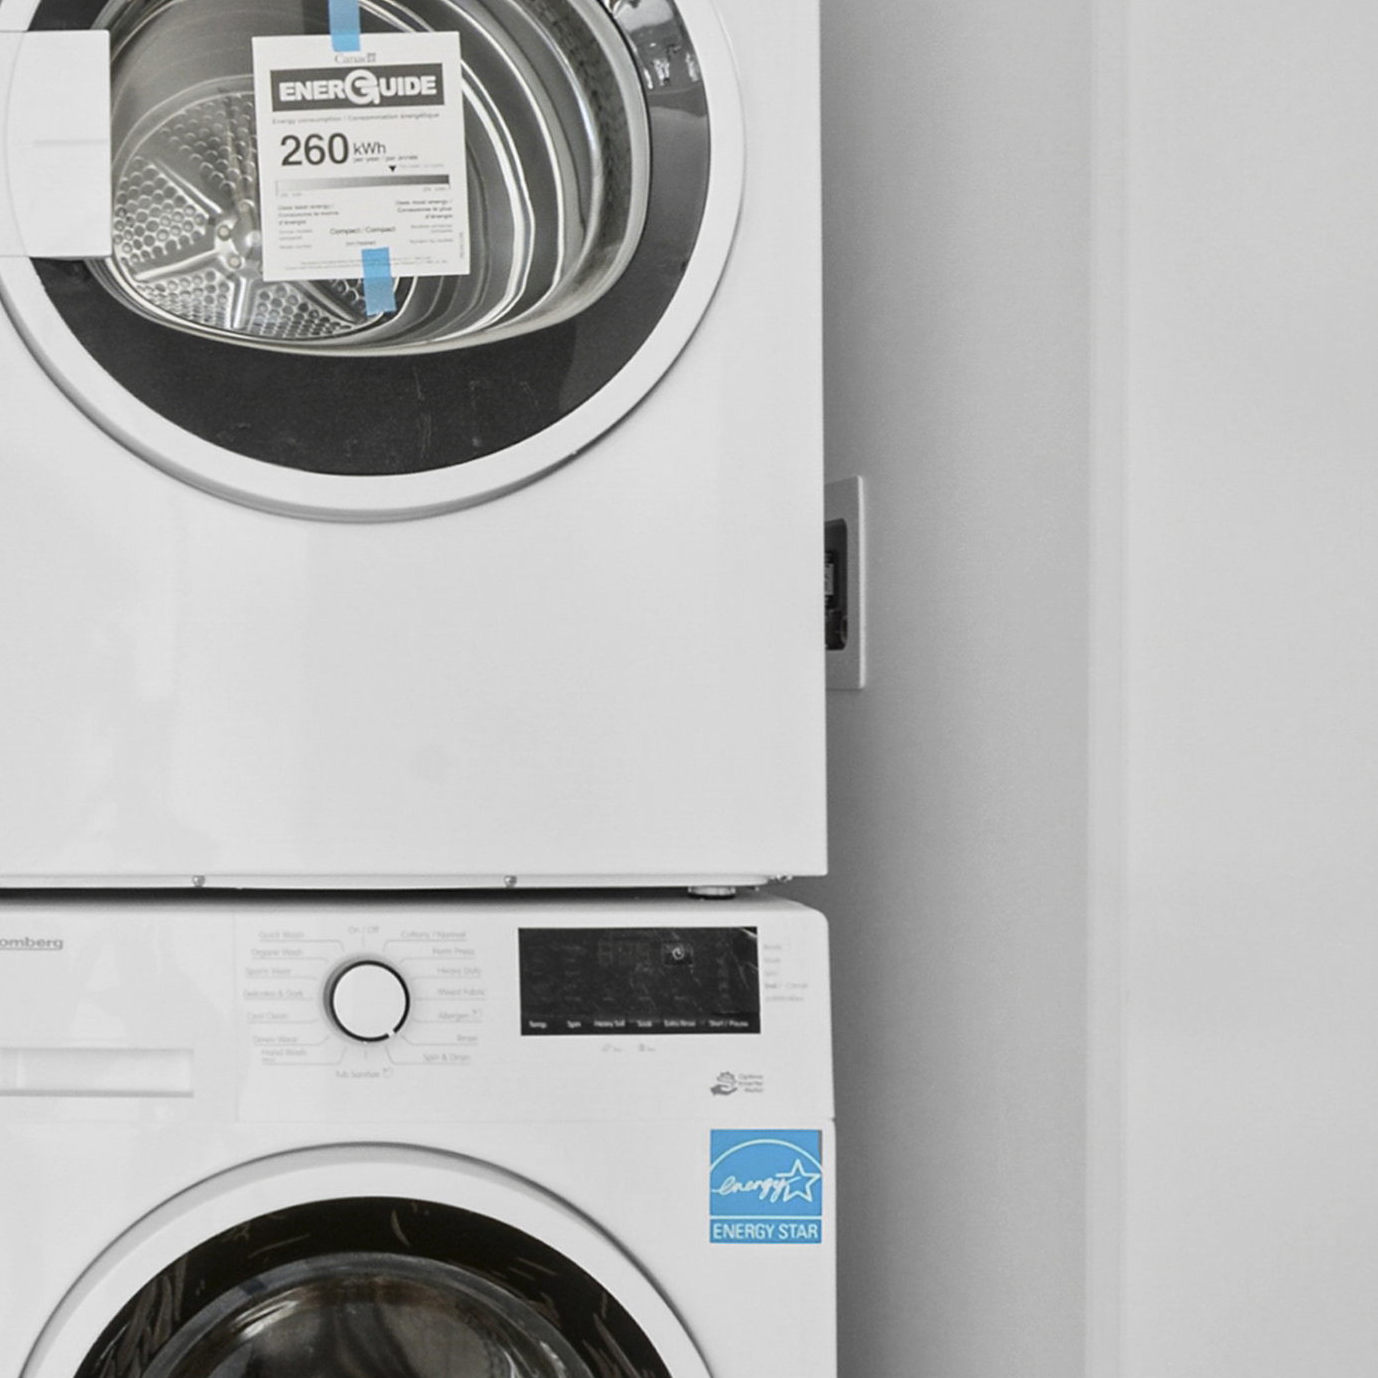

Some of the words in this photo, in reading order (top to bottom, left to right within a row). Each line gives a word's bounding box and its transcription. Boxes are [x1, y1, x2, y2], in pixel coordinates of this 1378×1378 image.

[279, 68, 438, 105] ENERGUIDE
[280, 131, 350, 166] 260
[353, 141, 387, 156] kWh
[712, 1175, 790, 1204] energy
[713, 1223, 775, 1240] ENERGY
[778, 1223, 818, 1240] STAR
